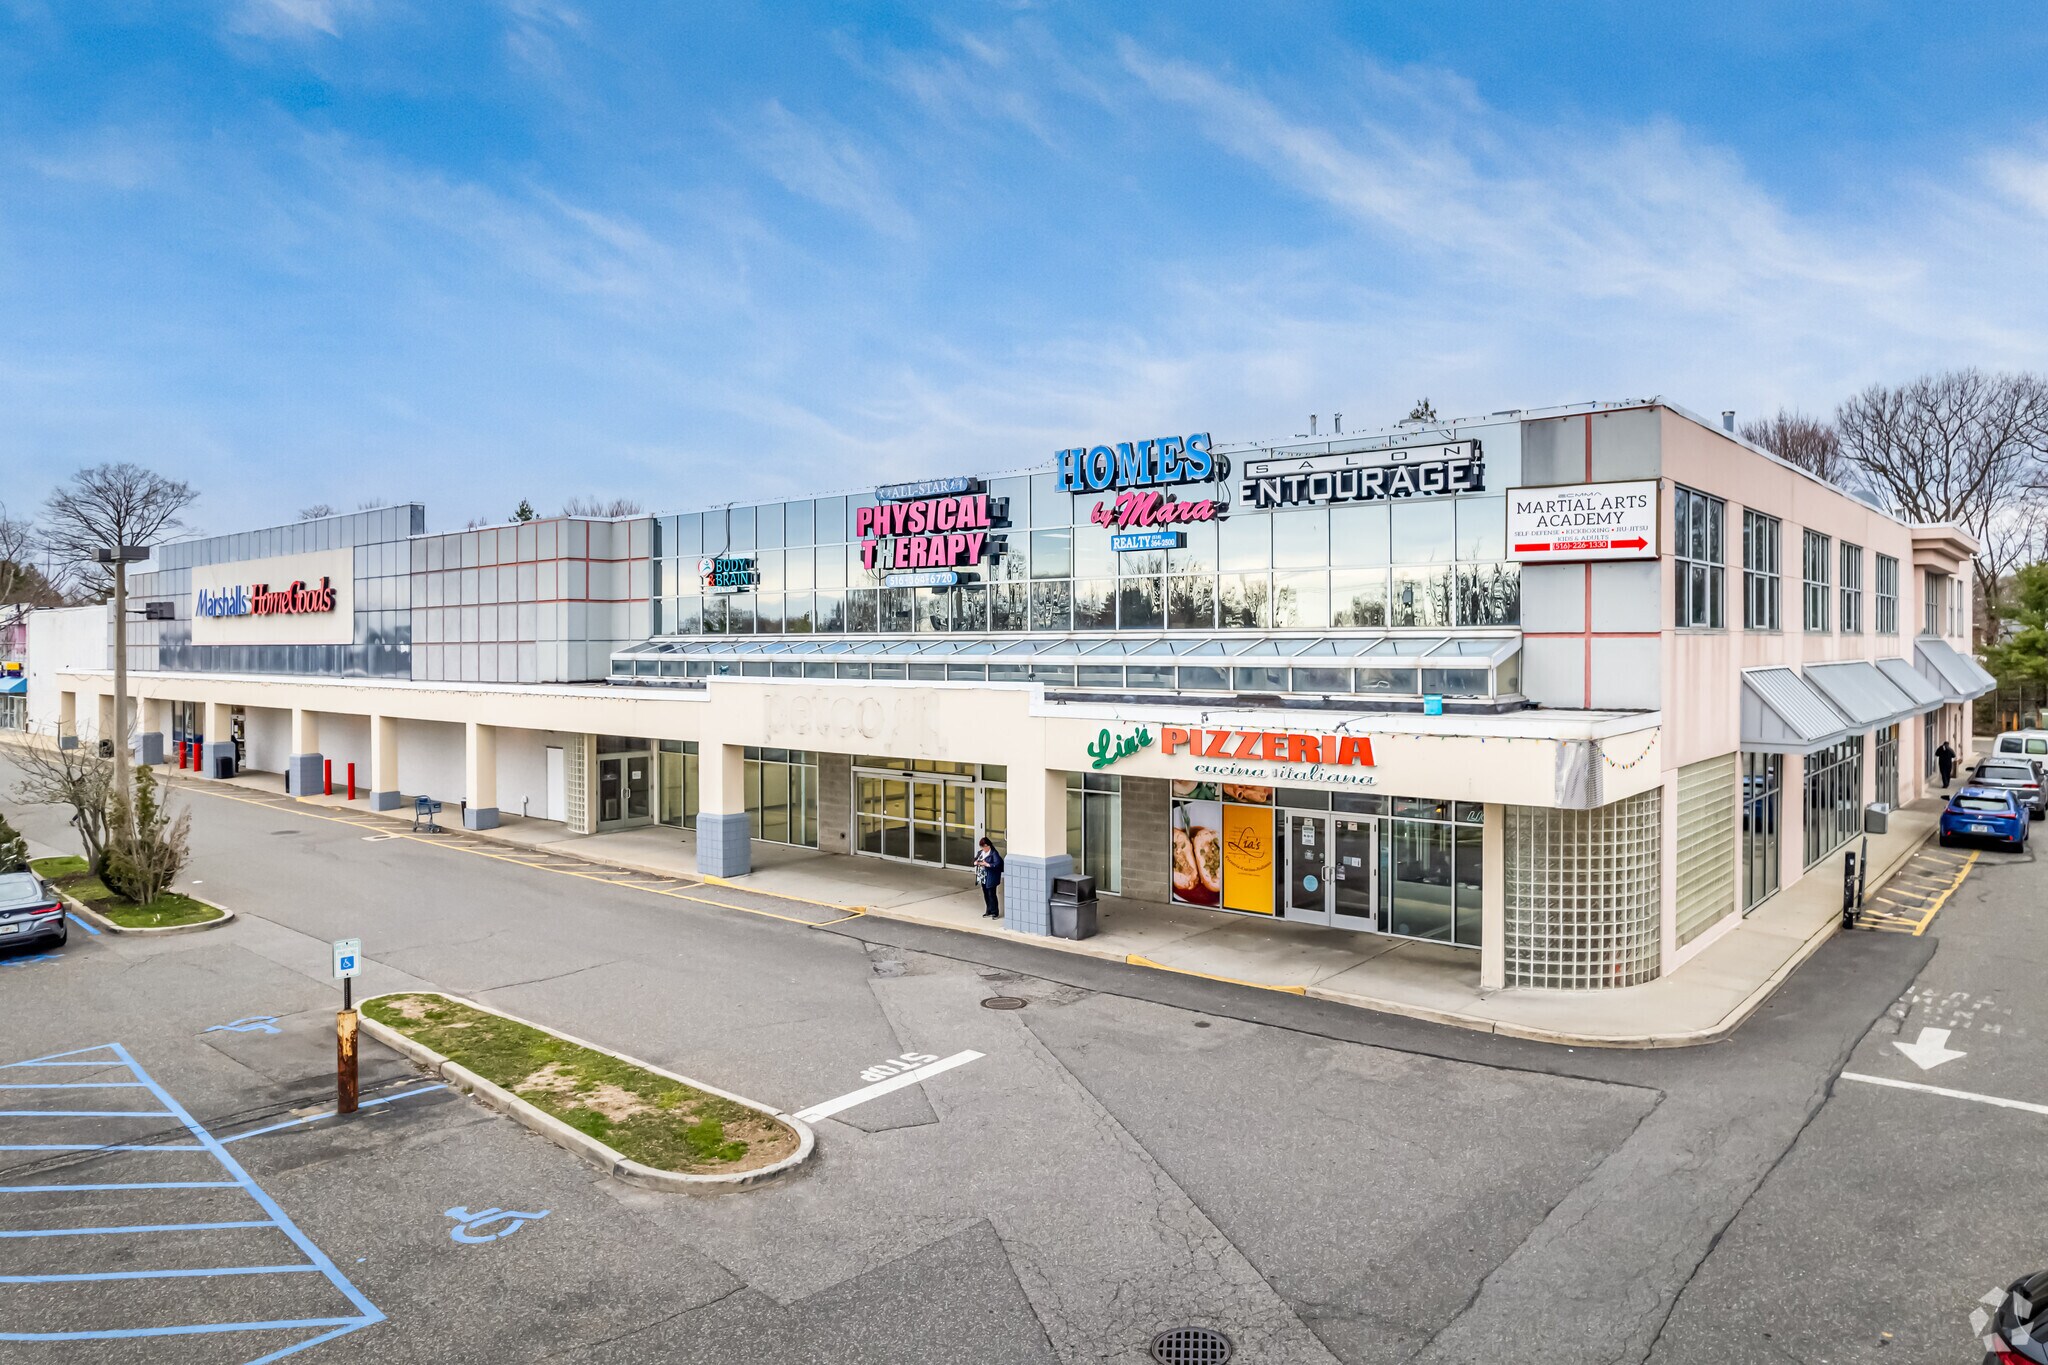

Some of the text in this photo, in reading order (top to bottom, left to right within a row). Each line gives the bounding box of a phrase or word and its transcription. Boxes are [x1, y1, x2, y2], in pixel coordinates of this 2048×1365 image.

[1055, 432, 1212, 493] HOMES
[1255, 445, 1461, 474] SALON
[892, 480, 950, 496] ALL-STAR
[1238, 459, 1472, 506] ENTOURAGE
[857, 494, 991, 537] PHYSICAL
[1091, 491, 1216, 529] by Mara
[1516, 494, 1648, 514] MARTIAL ARTS
[1536, 511, 1625, 528] ACADEMY
[1565, 527, 1610, 535] KICKBOXING
[861, 532, 985, 570] THERAPY
[1112, 535, 1152, 550] REALTY
[708, 573, 749, 586] & BRAIN
[716, 559, 745, 572] BODY
[196, 577, 332, 617] Marshalls HomeGoods
[1087, 727, 1376, 769] Lia's PIZZERIA
[1194, 763, 1268, 778] cucina
[1228, 826, 1265, 858] Lia's
[860, 1052, 939, 1082] STOP
